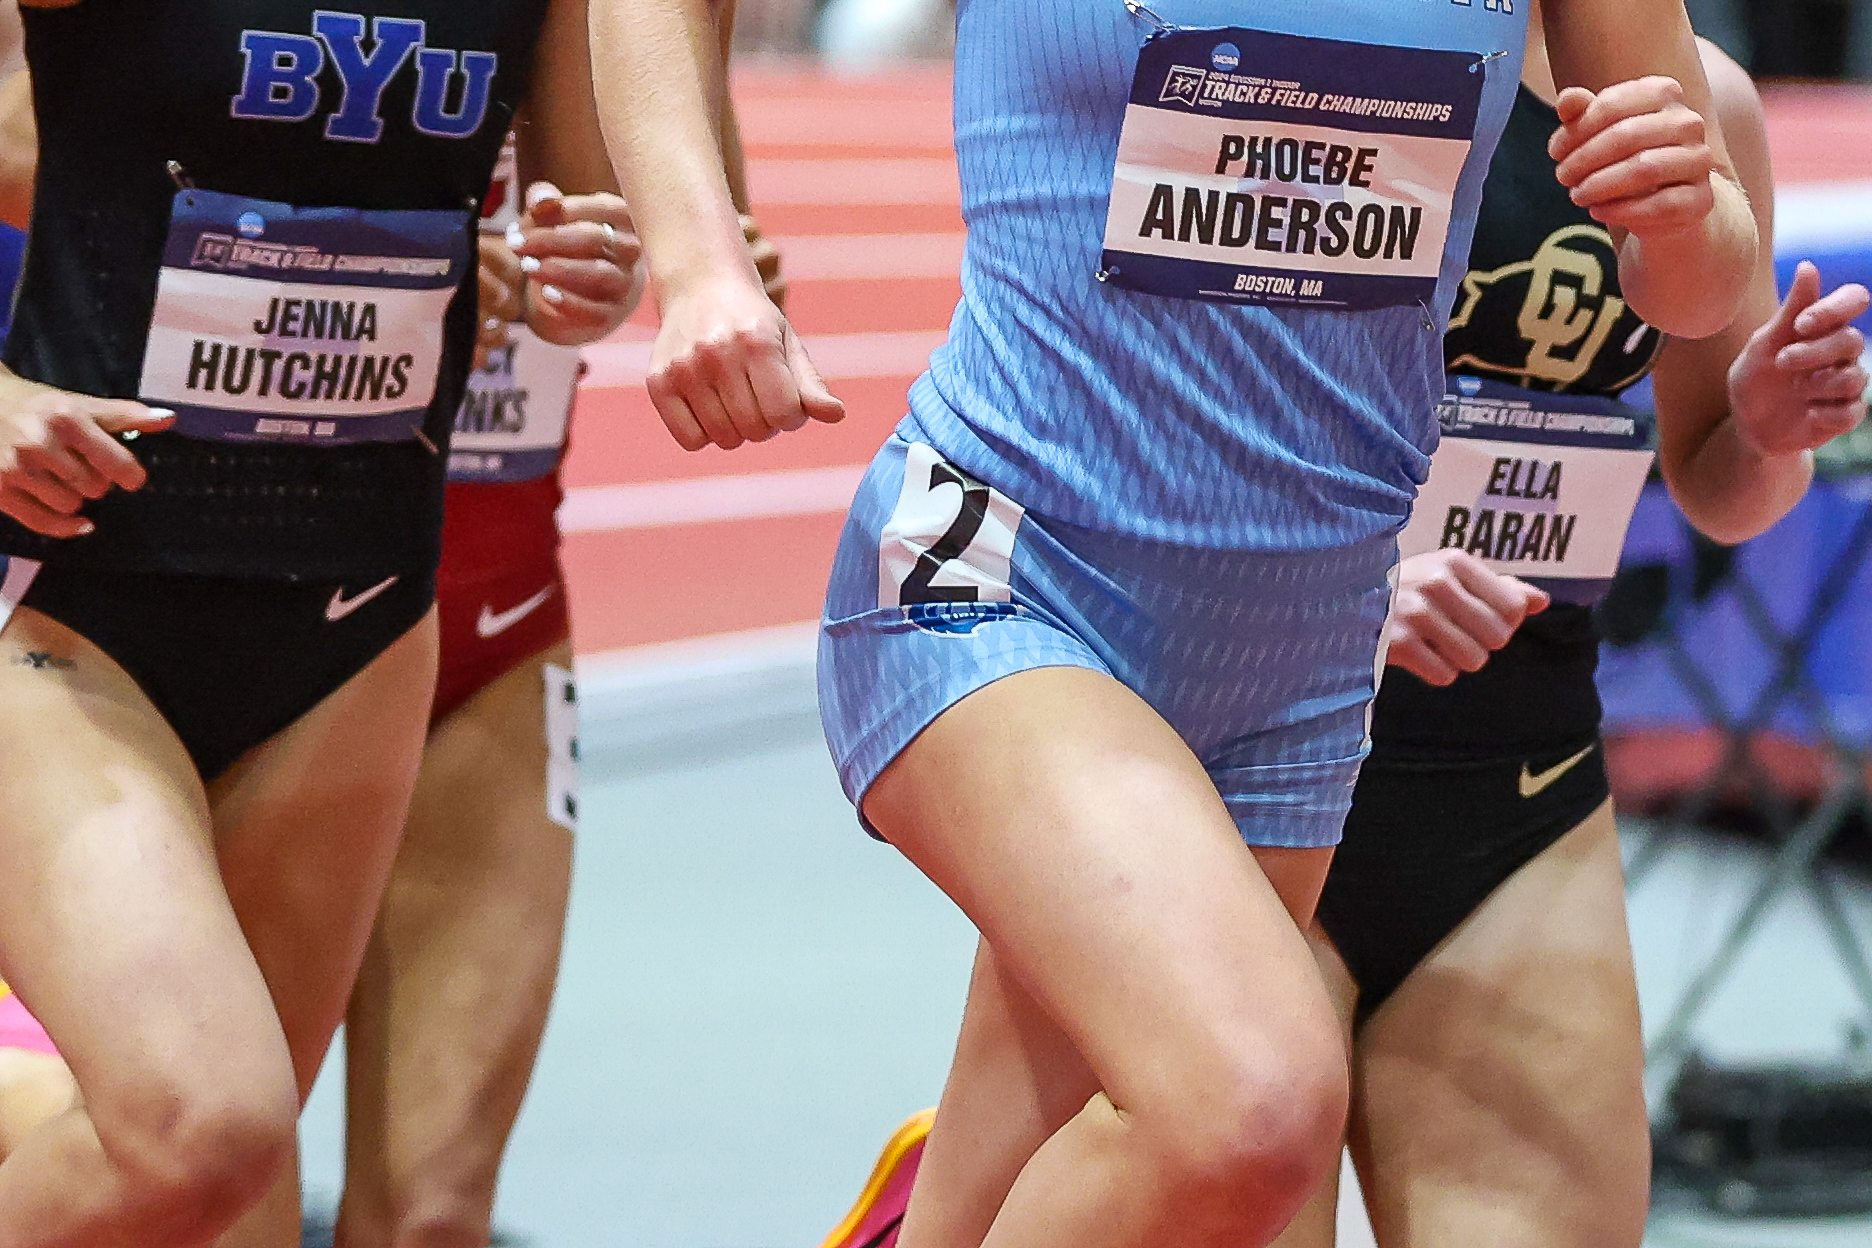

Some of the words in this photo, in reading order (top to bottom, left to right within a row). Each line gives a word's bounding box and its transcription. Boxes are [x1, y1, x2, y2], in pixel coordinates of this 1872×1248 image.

[231, 9, 497, 143] BYU
[1203, 80, 1258, 104] TRACK
[1258, 89, 1271, 104] &
[1271, 90, 1318, 110] FIELD
[1319, 93, 1452, 122] CHAMPIONSHIPS
[1215, 134, 1378, 188] PHOEBE
[1138, 183, 1423, 261] ANDERSON
[1233, 273, 1296, 297] BOSTON,
[1299, 278, 1324, 297] MA
[254, 298, 378, 341] JENNA
[186, 340, 413, 400] HUTCHINS
[1485, 457, 1563, 500] ELLA
[899, 462, 990, 603] 2
[1439, 505, 1577, 562] BARAN
